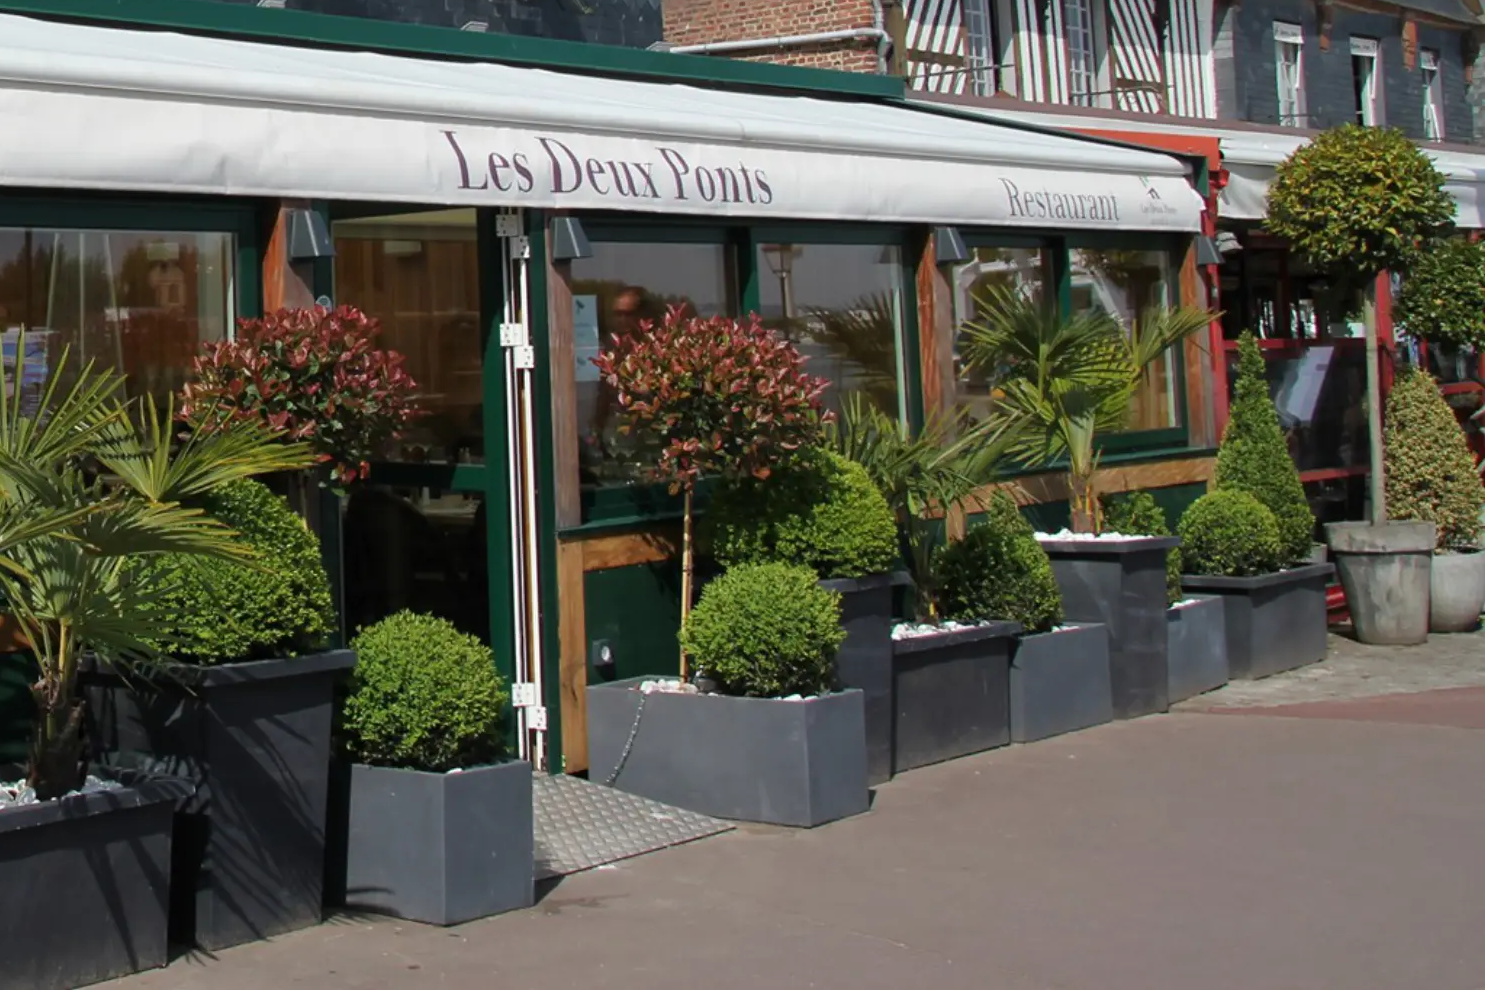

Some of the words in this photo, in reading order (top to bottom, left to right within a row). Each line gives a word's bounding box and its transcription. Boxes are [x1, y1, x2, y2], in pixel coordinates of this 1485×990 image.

[439, 130, 535, 193] Les
[534, 136, 662, 200] Deux
[654, 147, 774, 205] Ponts
[997, 177, 1120, 222] Restaurant
